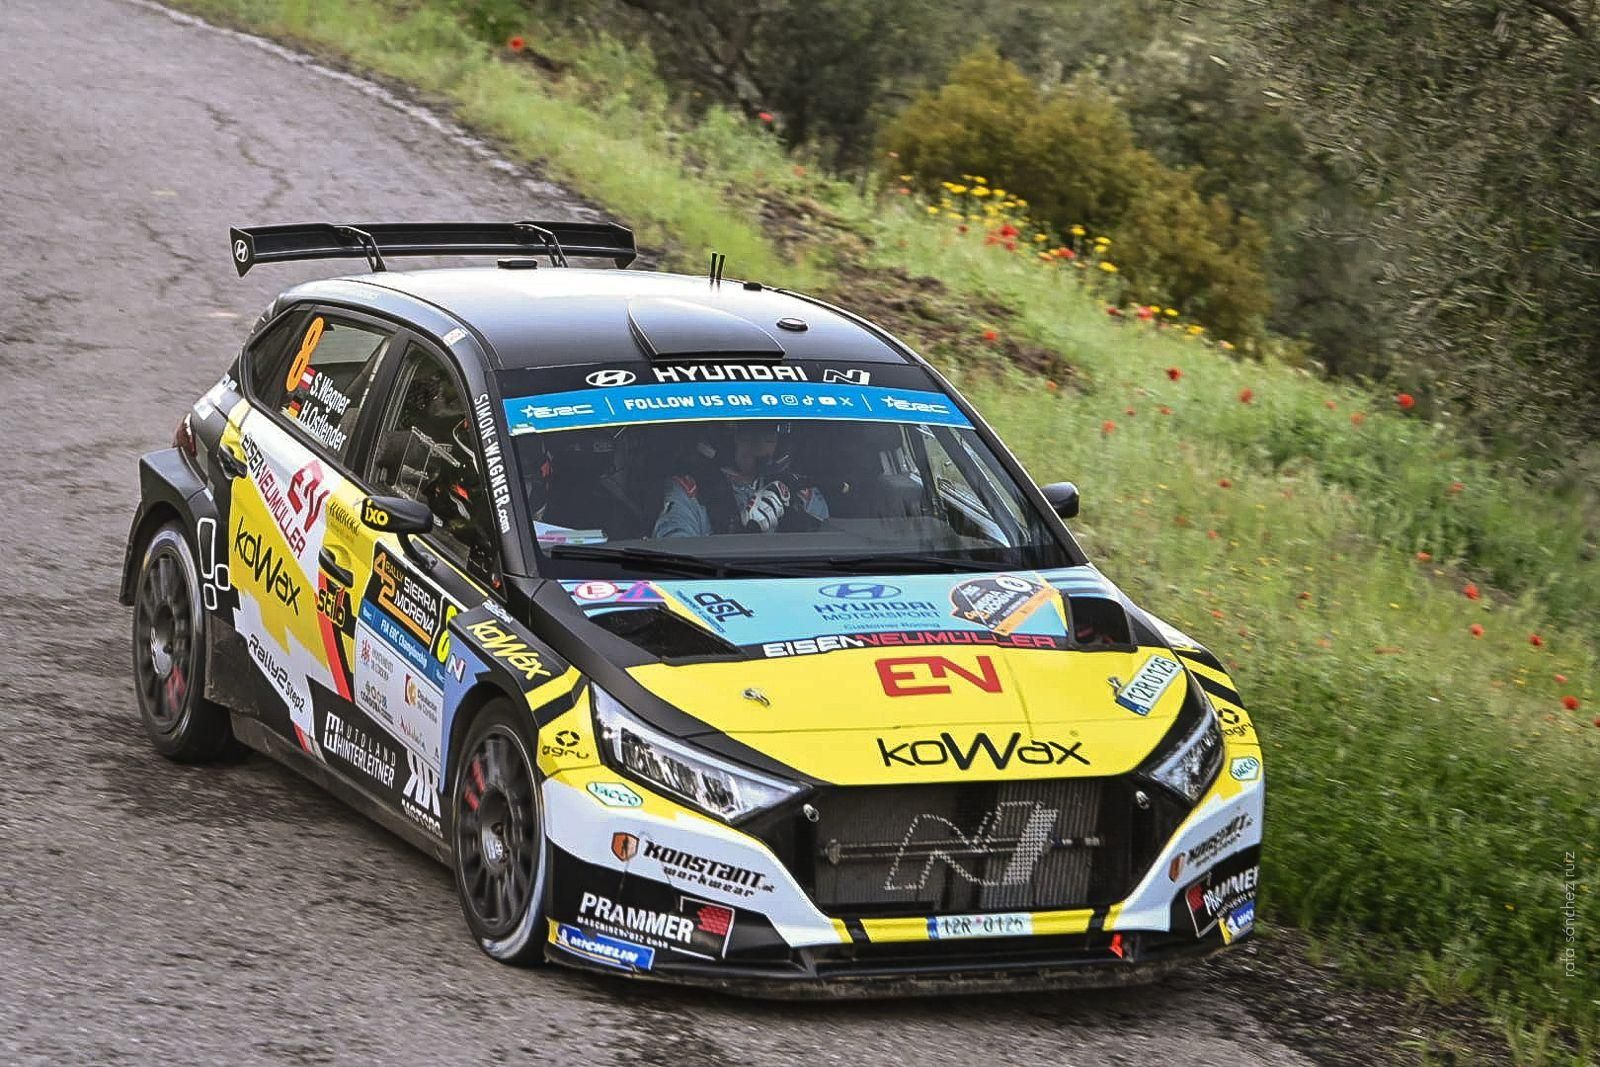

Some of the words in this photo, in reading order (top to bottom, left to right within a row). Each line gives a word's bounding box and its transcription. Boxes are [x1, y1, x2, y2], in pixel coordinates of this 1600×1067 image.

[286, 316, 324, 392] 8
[652, 365, 808, 383] HYUNDAI
[309, 372, 351, 415] S.Wagner
[624, 396, 695, 411] FOLLOW
[699, 395, 724, 407] US
[728, 394, 752, 406] ON
[299, 400, 347, 451] H.Ostlender
[474, 393, 510, 534] SIMON-WAGNER.com
[394, 590, 435, 635] MORENA
[403, 576, 437, 616] SIERRA
[814, 601, 937, 616] HYUNDAI
[821, 609, 941, 622] MOTORSPORT
[248, 633, 289, 690] Rally2
[286, 680, 305, 713] Step2
[874, 655, 1003, 697] EN
[335, 737, 395, 790] HINTERLEITNER
[338, 720, 396, 767] AUTOLAND
[541, 744, 589, 760] agru
[1231, 758, 1257, 778] YACCO
[592, 784, 639, 806] YACCO
[663, 865, 755, 898] workwear
[579, 891, 694, 944] PRAMMER
[569, 936, 640, 963] MICHELIN
